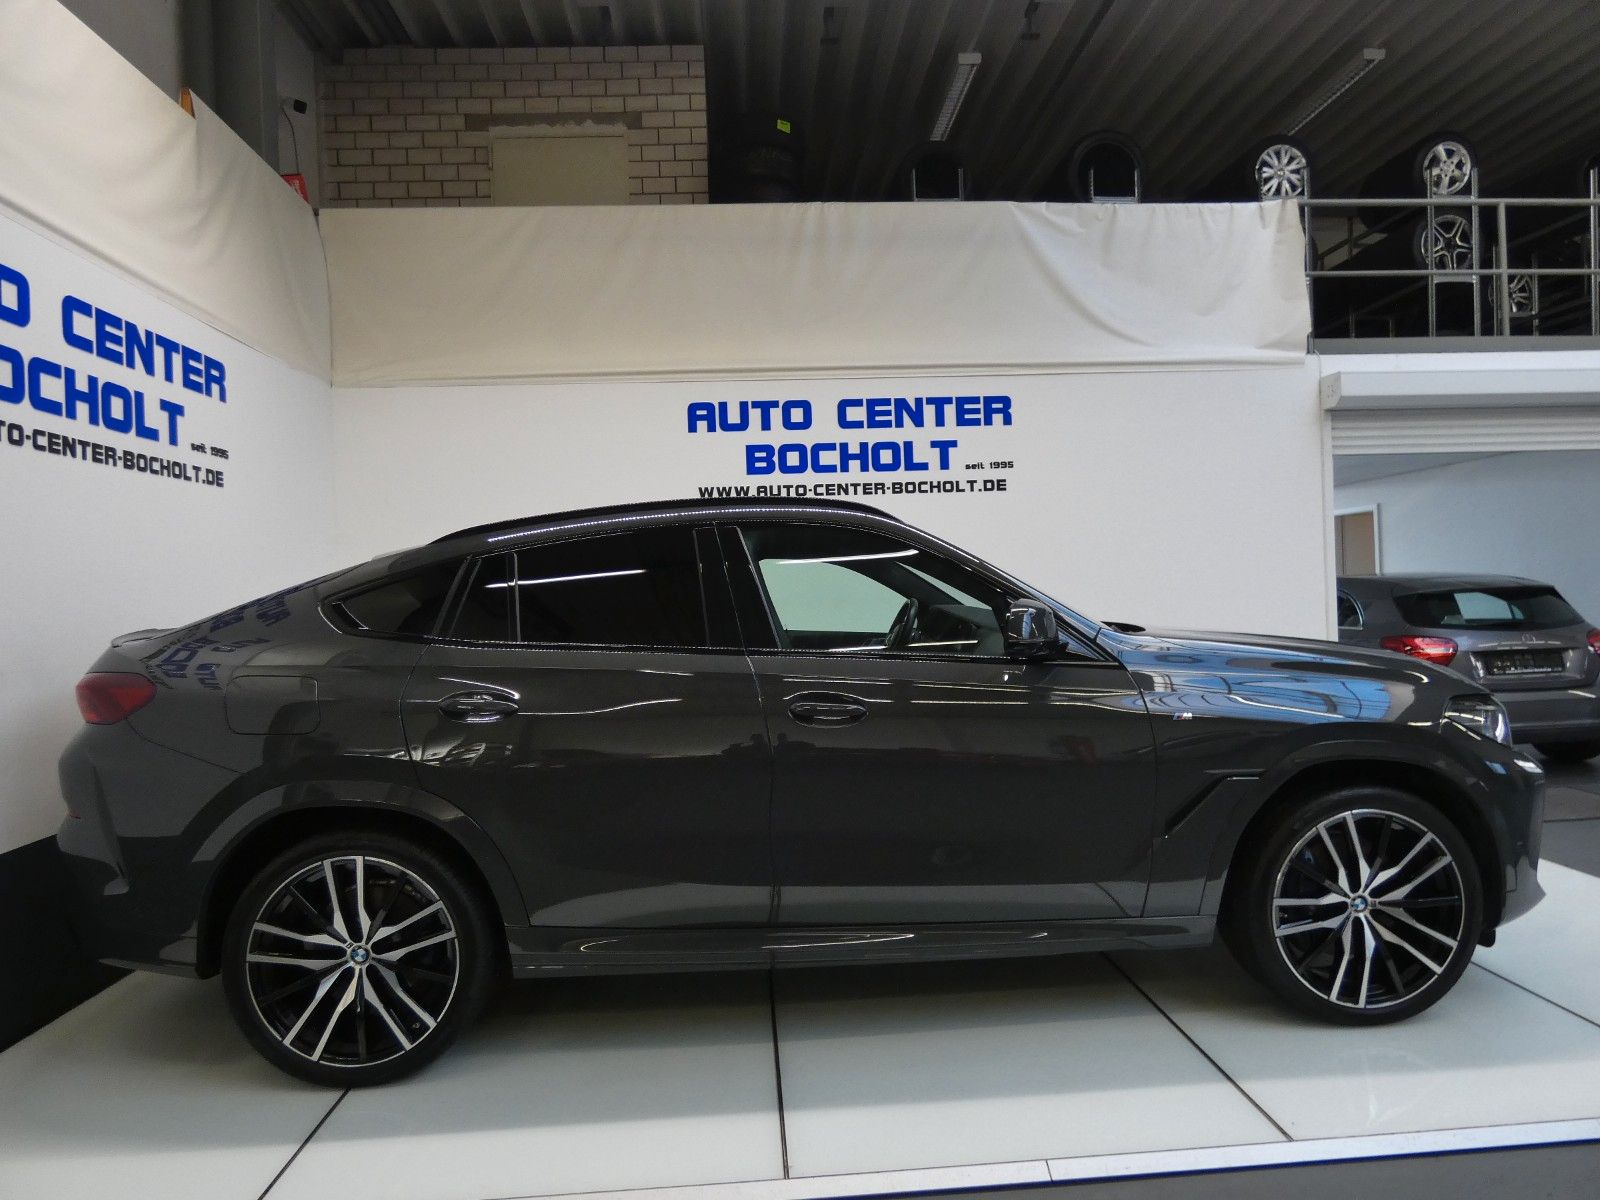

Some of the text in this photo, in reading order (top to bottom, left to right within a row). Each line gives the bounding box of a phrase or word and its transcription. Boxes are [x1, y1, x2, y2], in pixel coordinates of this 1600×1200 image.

[62, 295, 227, 402] CENTER
[687, 395, 1013, 433] AUTO CENTER
[745, 439, 1014, 476] BOCHOLT seit 1995
[698, 479, 1007, 499] WWW.AUTO-CENTER-BOCHOLT.DE
